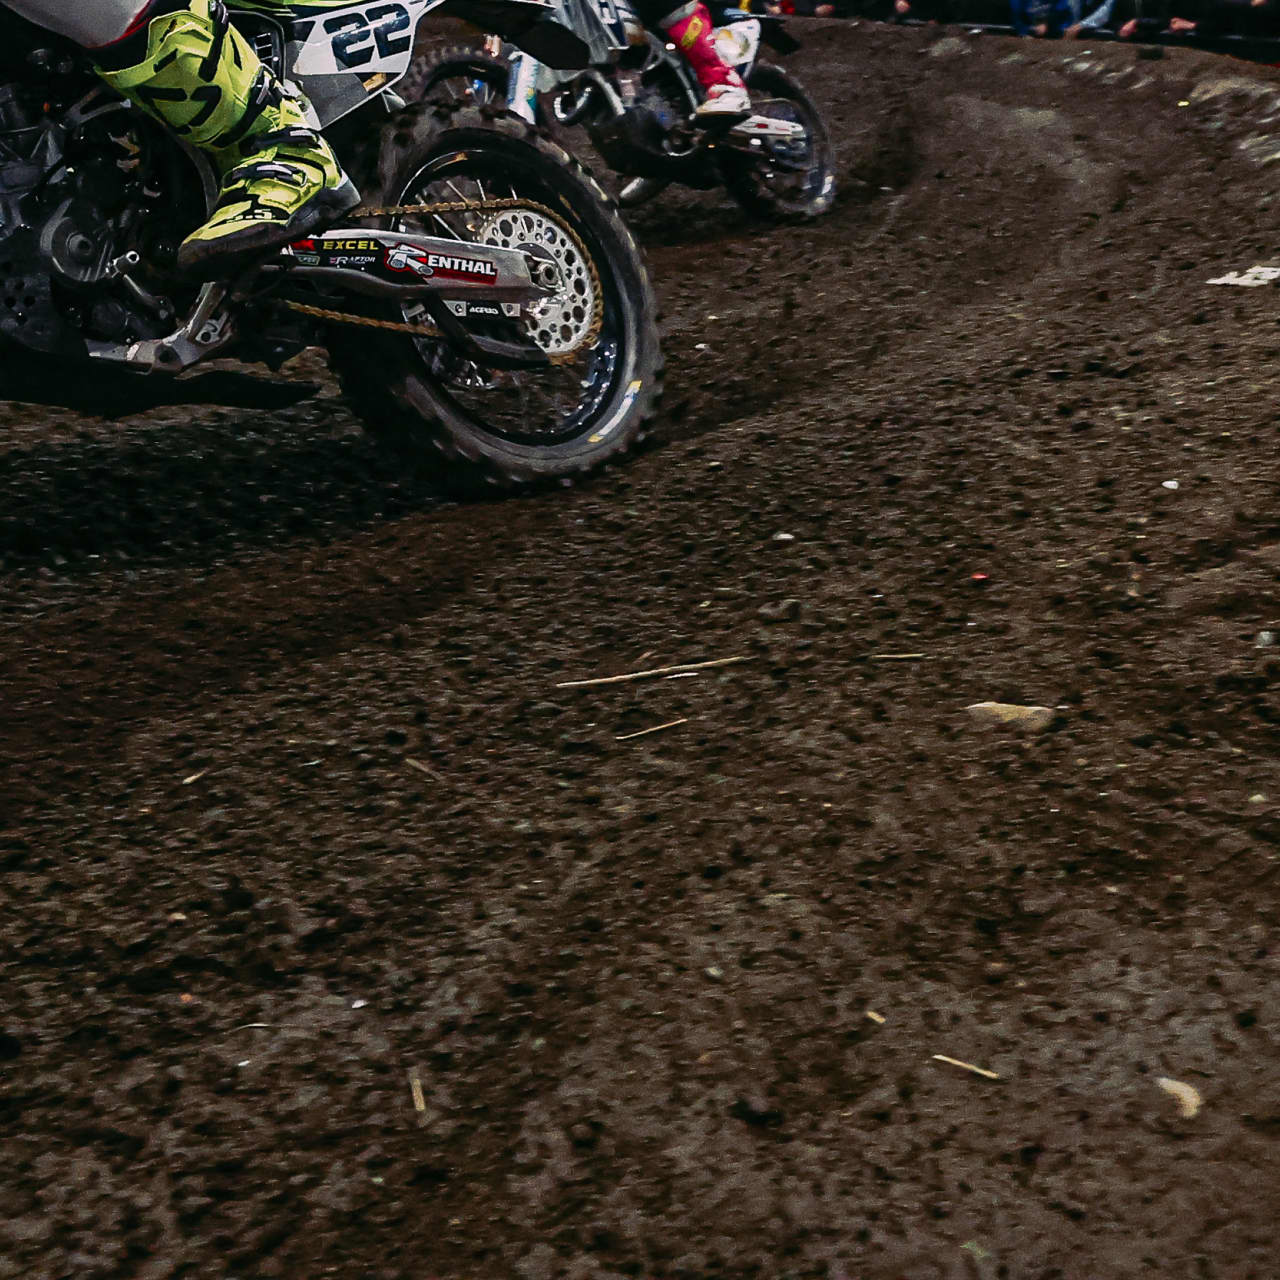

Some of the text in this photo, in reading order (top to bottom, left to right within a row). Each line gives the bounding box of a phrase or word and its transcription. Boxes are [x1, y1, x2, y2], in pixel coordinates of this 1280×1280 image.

[322, 3, 412, 72] 22
[323, 240, 379, 250] EXCEL
[386, 244, 496, 276] RENTHAL
